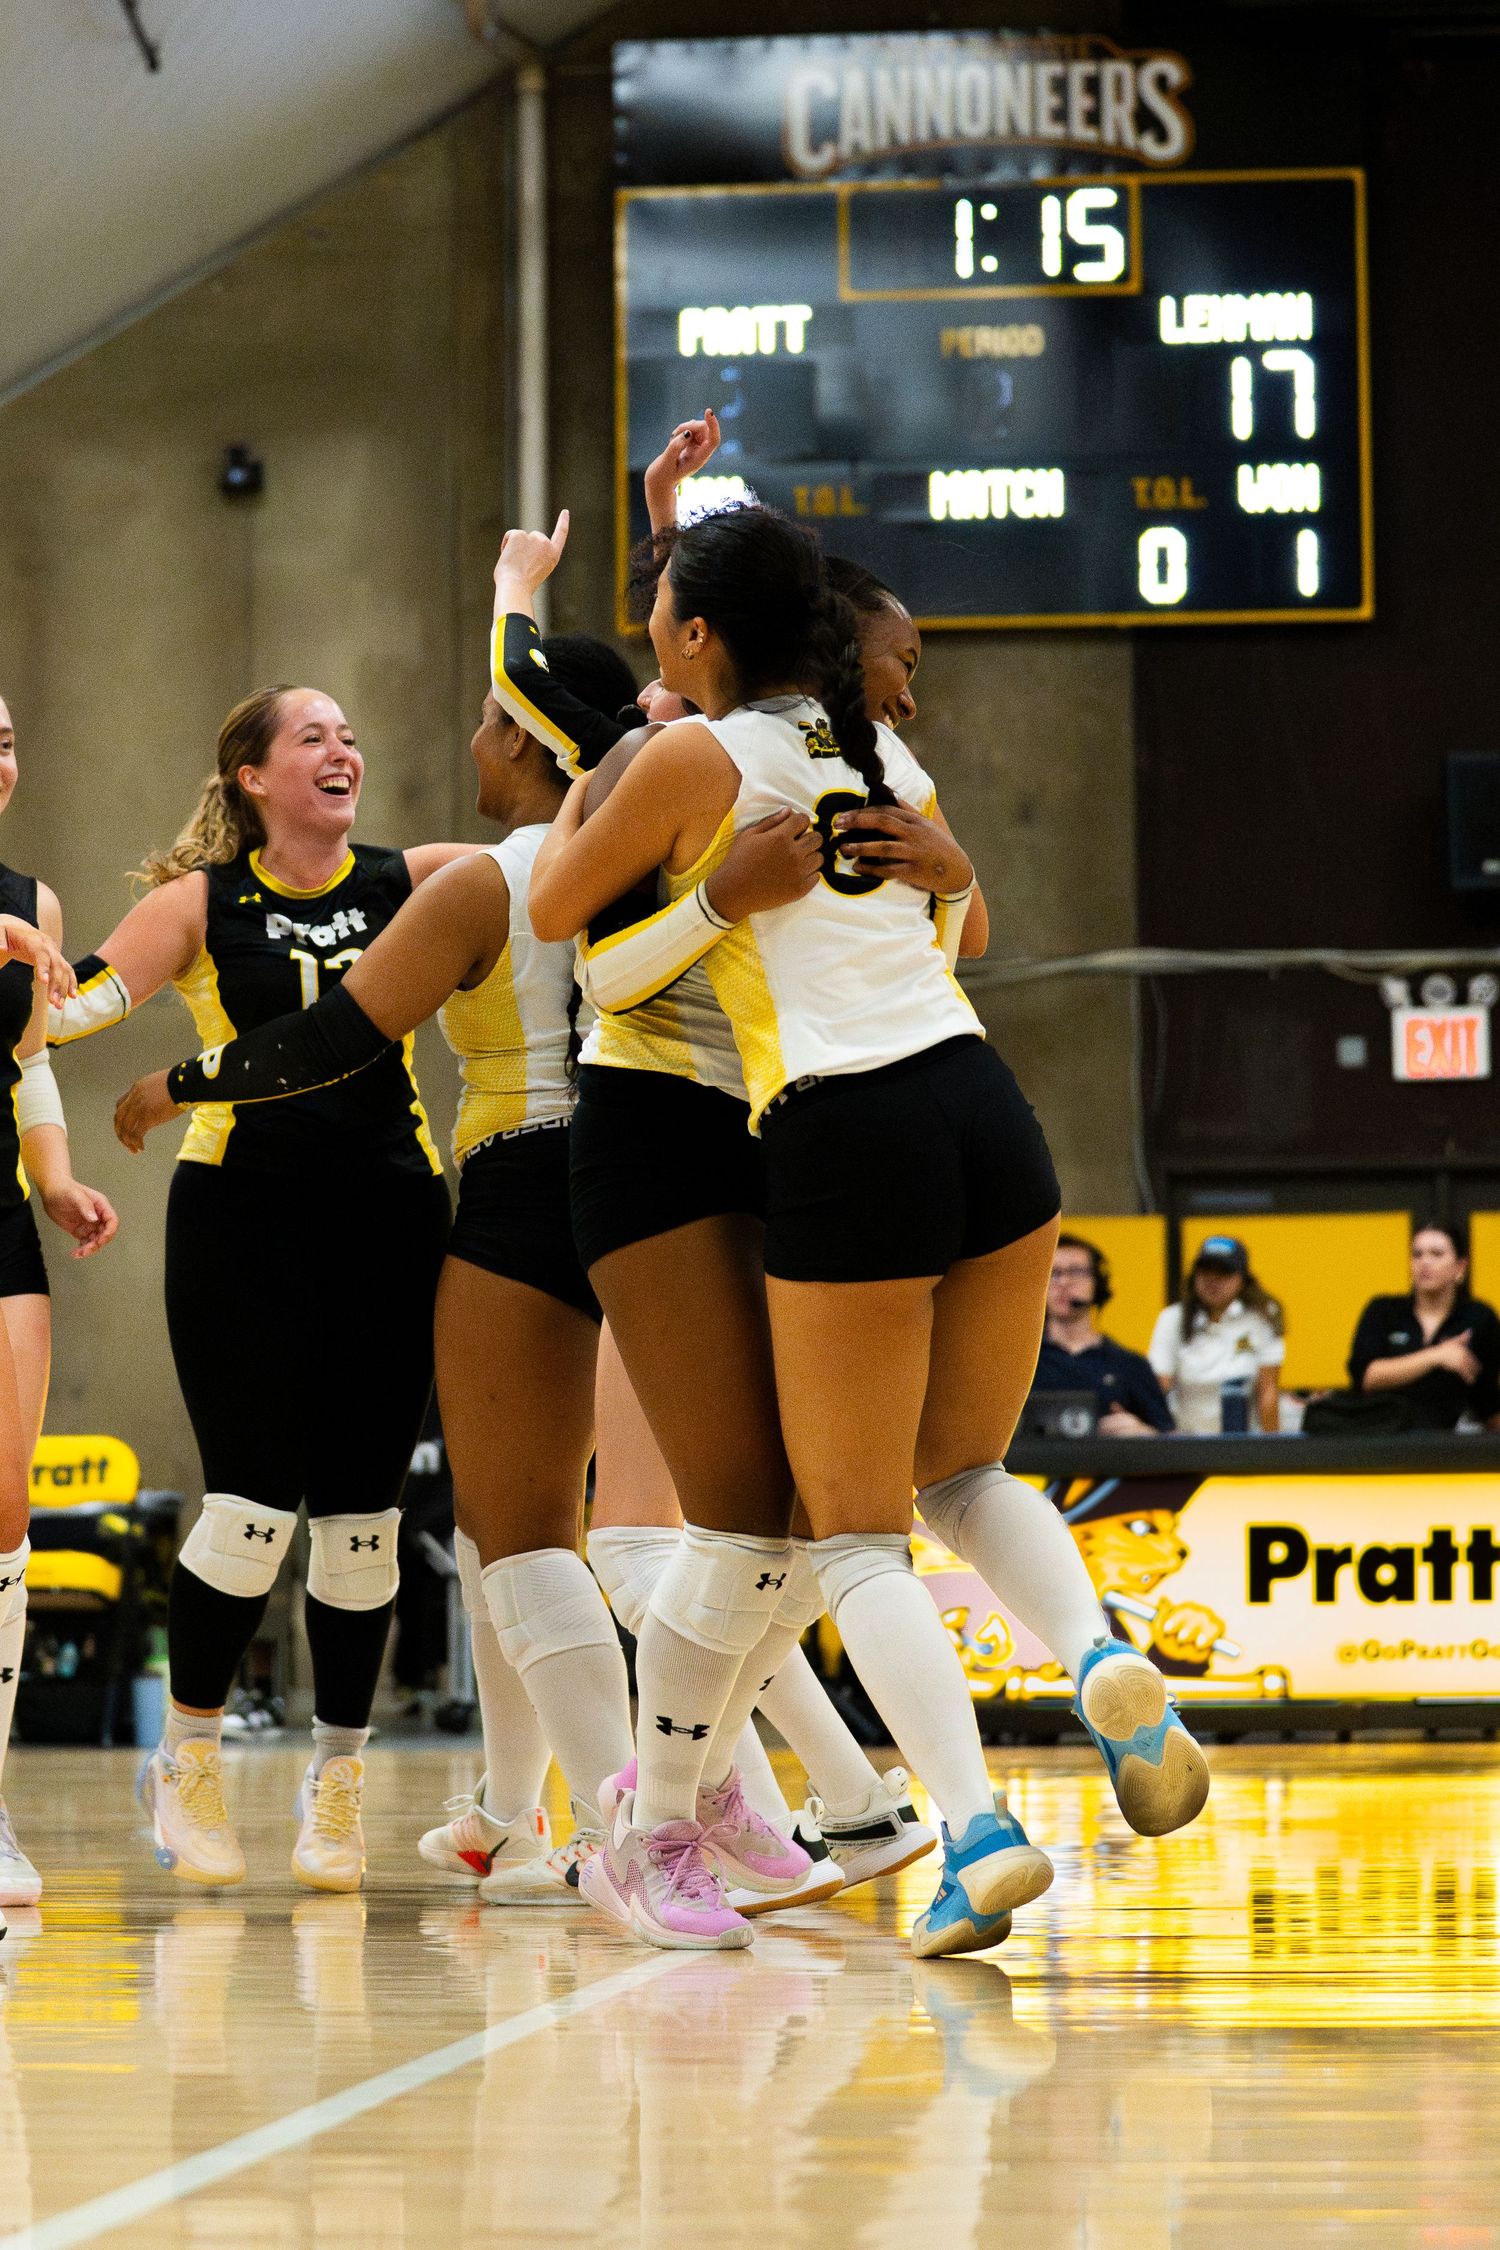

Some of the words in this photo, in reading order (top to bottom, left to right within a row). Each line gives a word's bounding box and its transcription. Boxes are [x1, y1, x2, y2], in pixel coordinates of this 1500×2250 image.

[784, 55, 1187, 172] CANNONEERS
[678, 304, 814, 357] PRATT
[939, 324, 1046, 361] PERIOD
[1159, 292, 1314, 345] LEHMAN
[1231, 349, 1317, 441] 17
[929, 468, 1066, 521] MATCH
[1138, 526, 1189, 605] 0
[1296, 528, 1320, 598] 1
[265, 906, 369, 947] Pratt
[1404, 1016, 1480, 1079] EXIT
[31, 1455, 110, 1488] ratt
[1247, 1524, 1500, 1604] Pratt
